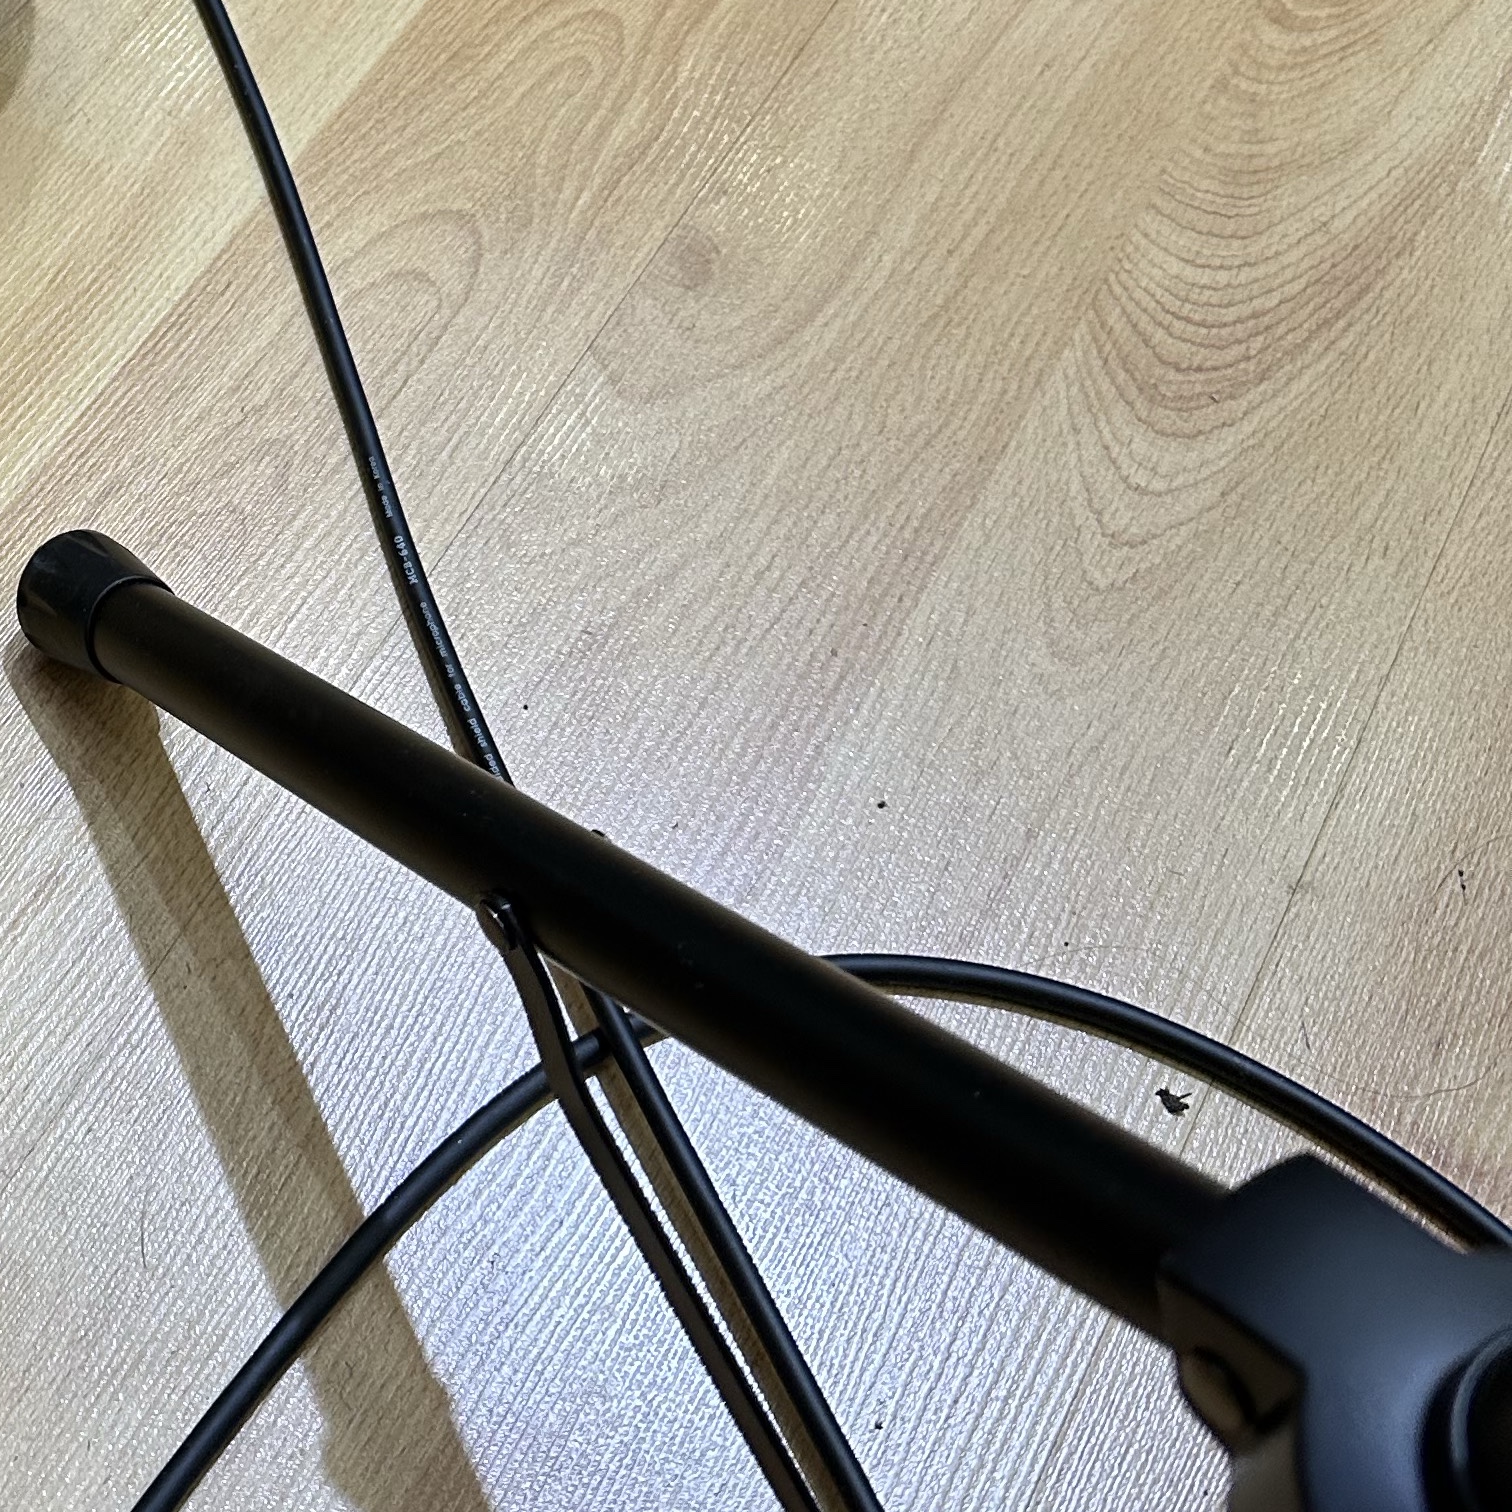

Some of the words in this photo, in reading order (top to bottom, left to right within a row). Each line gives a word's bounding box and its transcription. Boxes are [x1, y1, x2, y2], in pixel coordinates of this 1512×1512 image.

[393, 535, 419, 585] MCB-640
[419, 601, 448, 658] microphone
[445, 663, 456, 678] for
[454, 683, 472, 712] cable
[468, 717, 489, 748] shield
